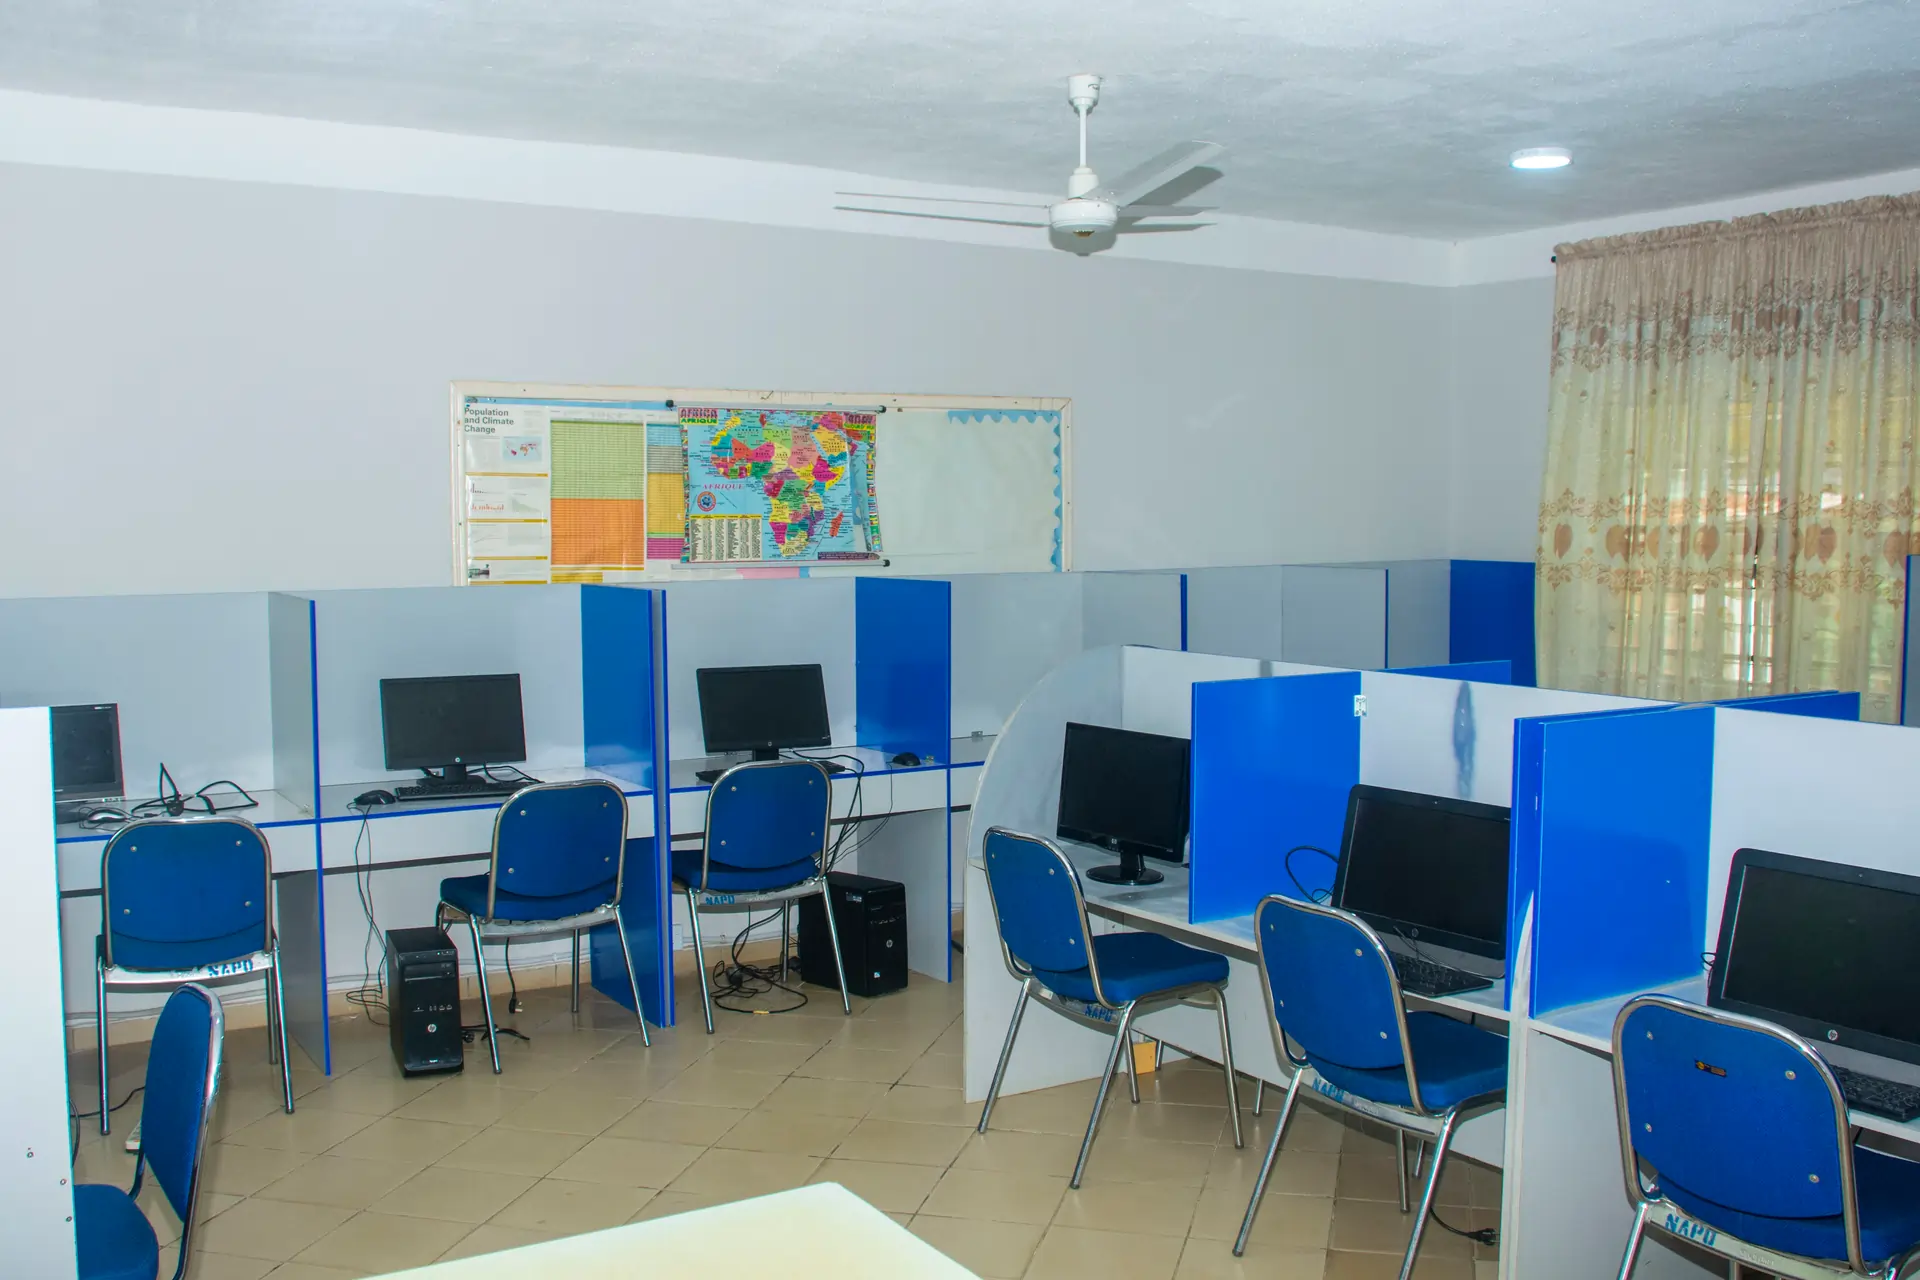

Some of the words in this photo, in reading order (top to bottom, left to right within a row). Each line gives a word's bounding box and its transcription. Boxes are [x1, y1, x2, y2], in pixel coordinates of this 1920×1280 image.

[464, 407, 509, 416] Population
[482, 416, 514, 425] Climate
[464, 424, 496, 434] Change
